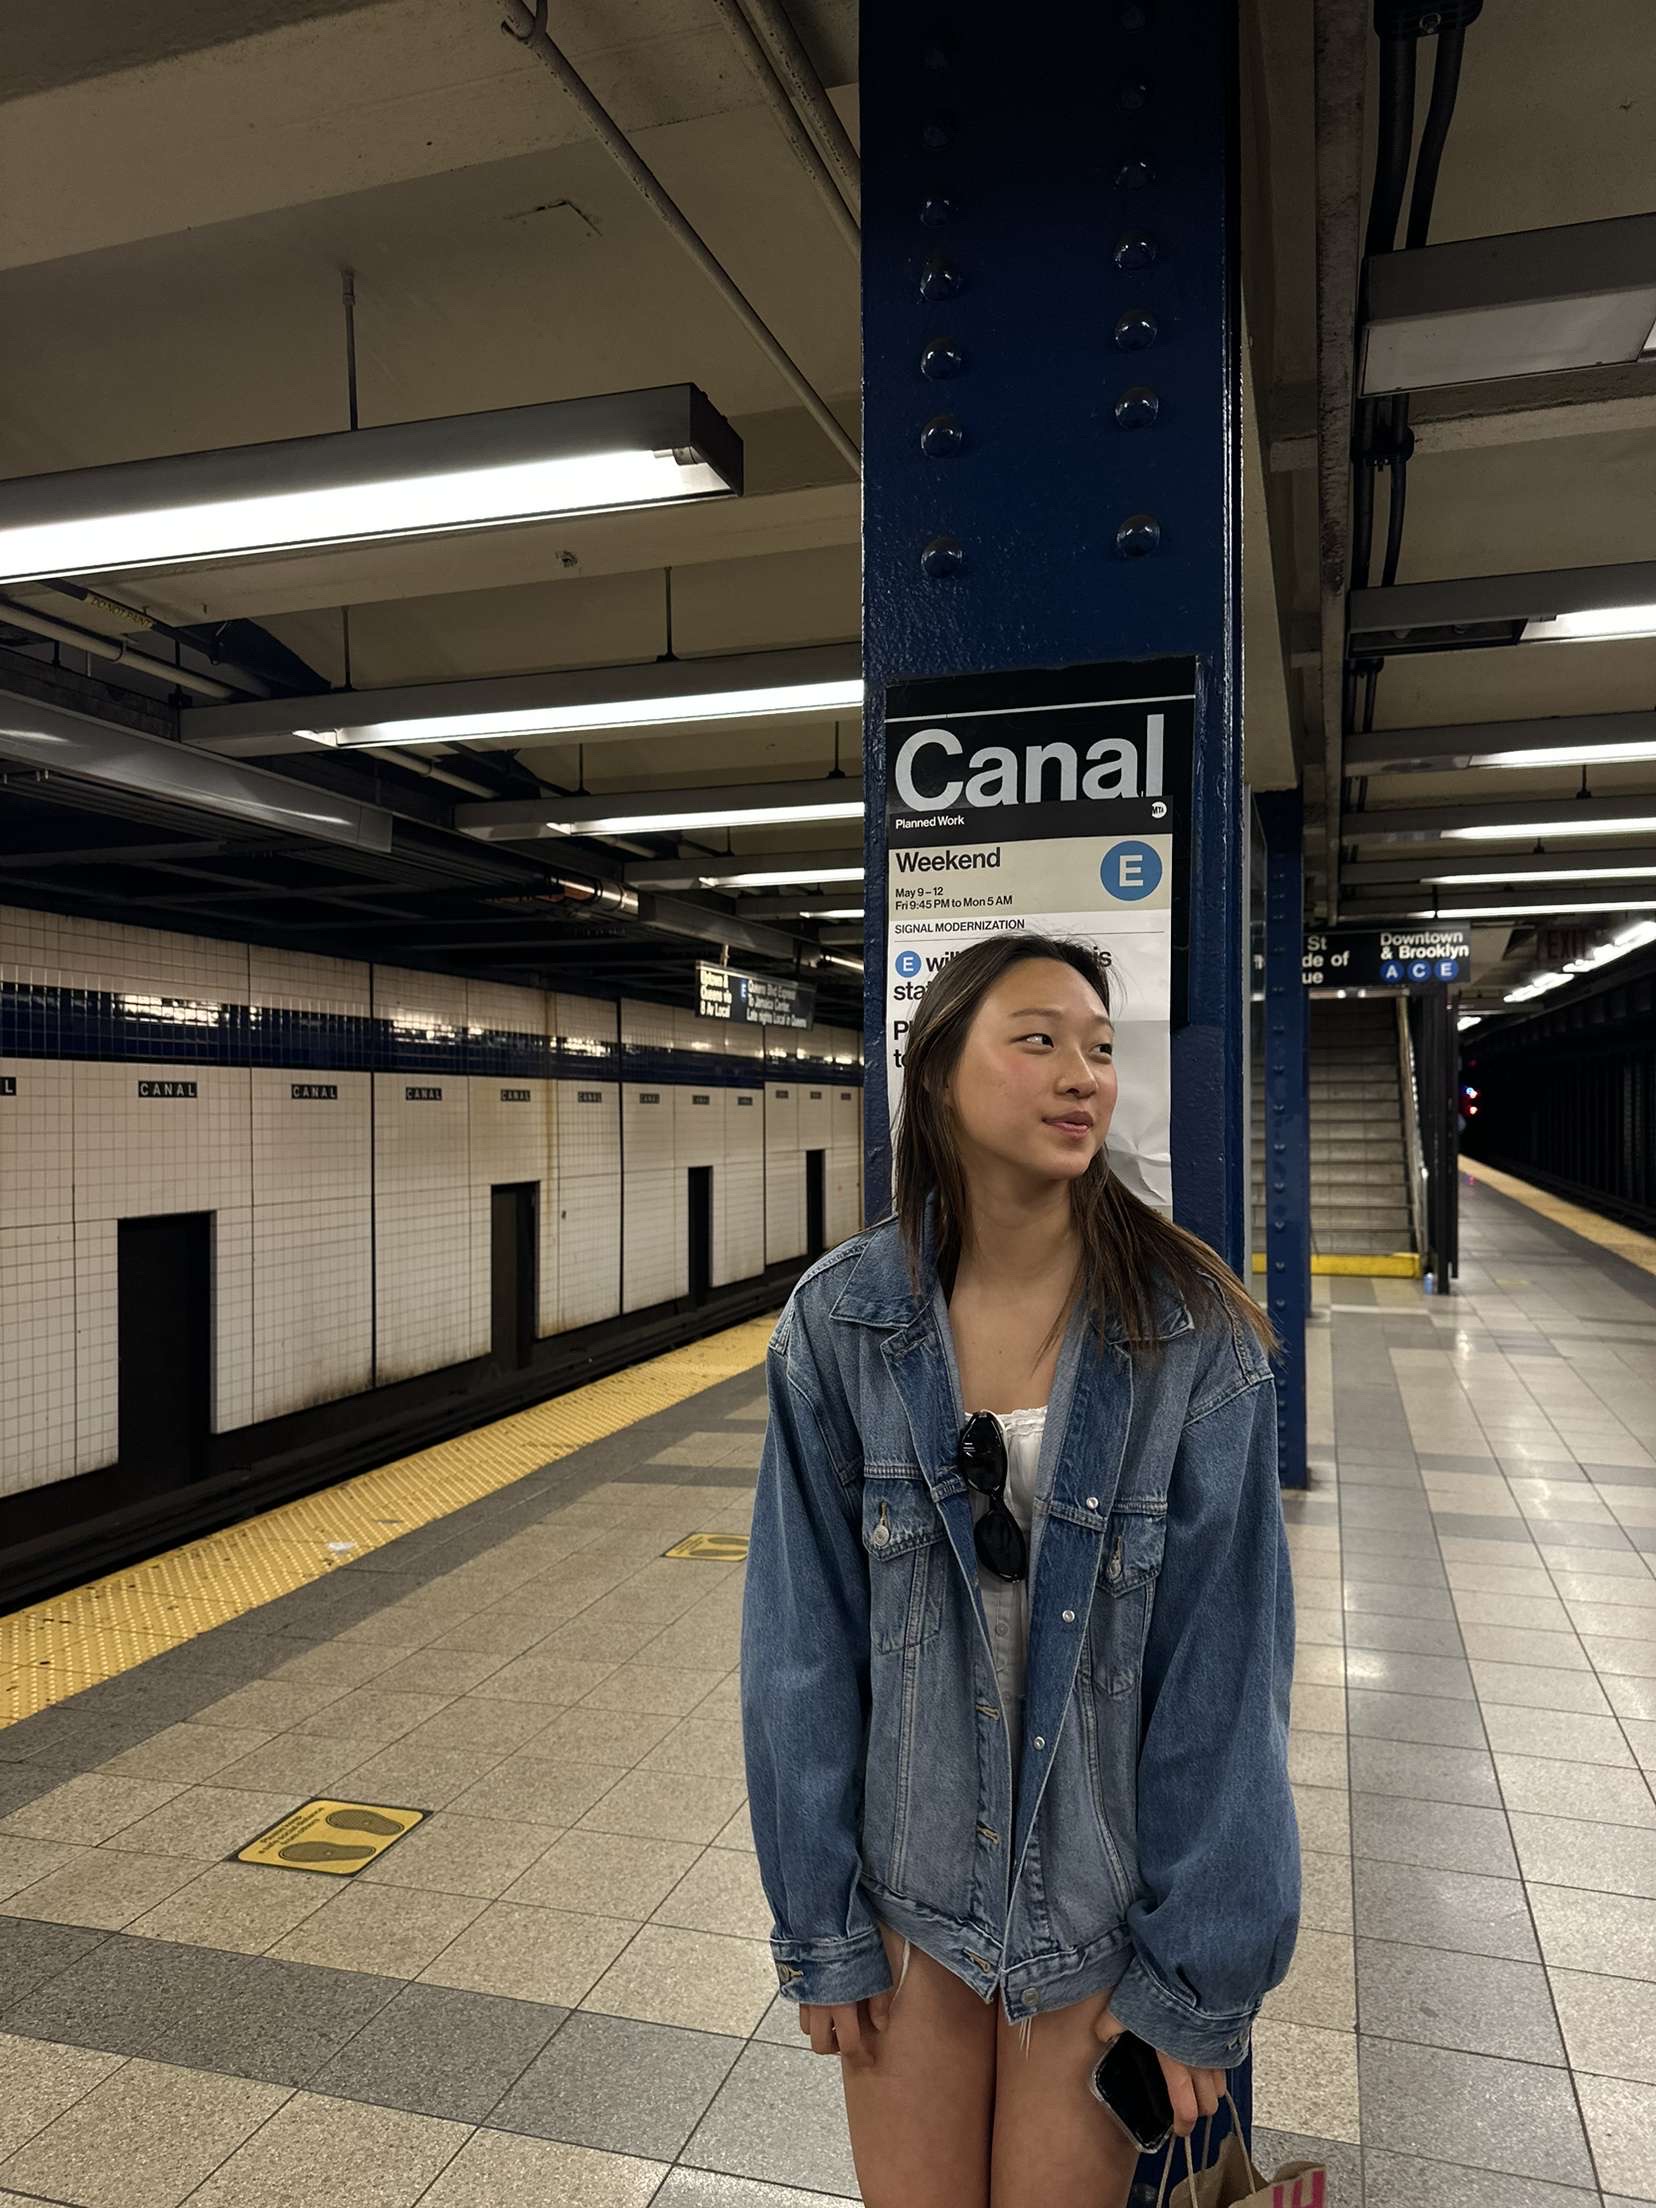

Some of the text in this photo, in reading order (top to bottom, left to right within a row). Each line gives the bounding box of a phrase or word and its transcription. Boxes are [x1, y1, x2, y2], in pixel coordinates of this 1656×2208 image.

[895, 714, 1164, 811] Canal
[896, 815, 965, 829] Planned Work
[896, 847, 1001, 873] Weekend
[1119, 855, 1143, 887] E
[896, 888, 916, 899] May
[896, 895, 1013, 910] Fri 9:45 PM to Mon 5 AM
[895, 919, 1025, 934] SIGNAL MODERNIZATION
[1307, 936, 1328, 951] St
[1380, 931, 1464, 947] Downtown
[1302, 950, 1350, 968] de of
[1380, 943, 1470, 961] & Brooklyn
[1385, 962, 1453, 979] A C E
[140, 1083, 195, 1097] CANAL
[293, 1086, 336, 1099] CANAL
[407, 1089, 441, 1099] CANAL
